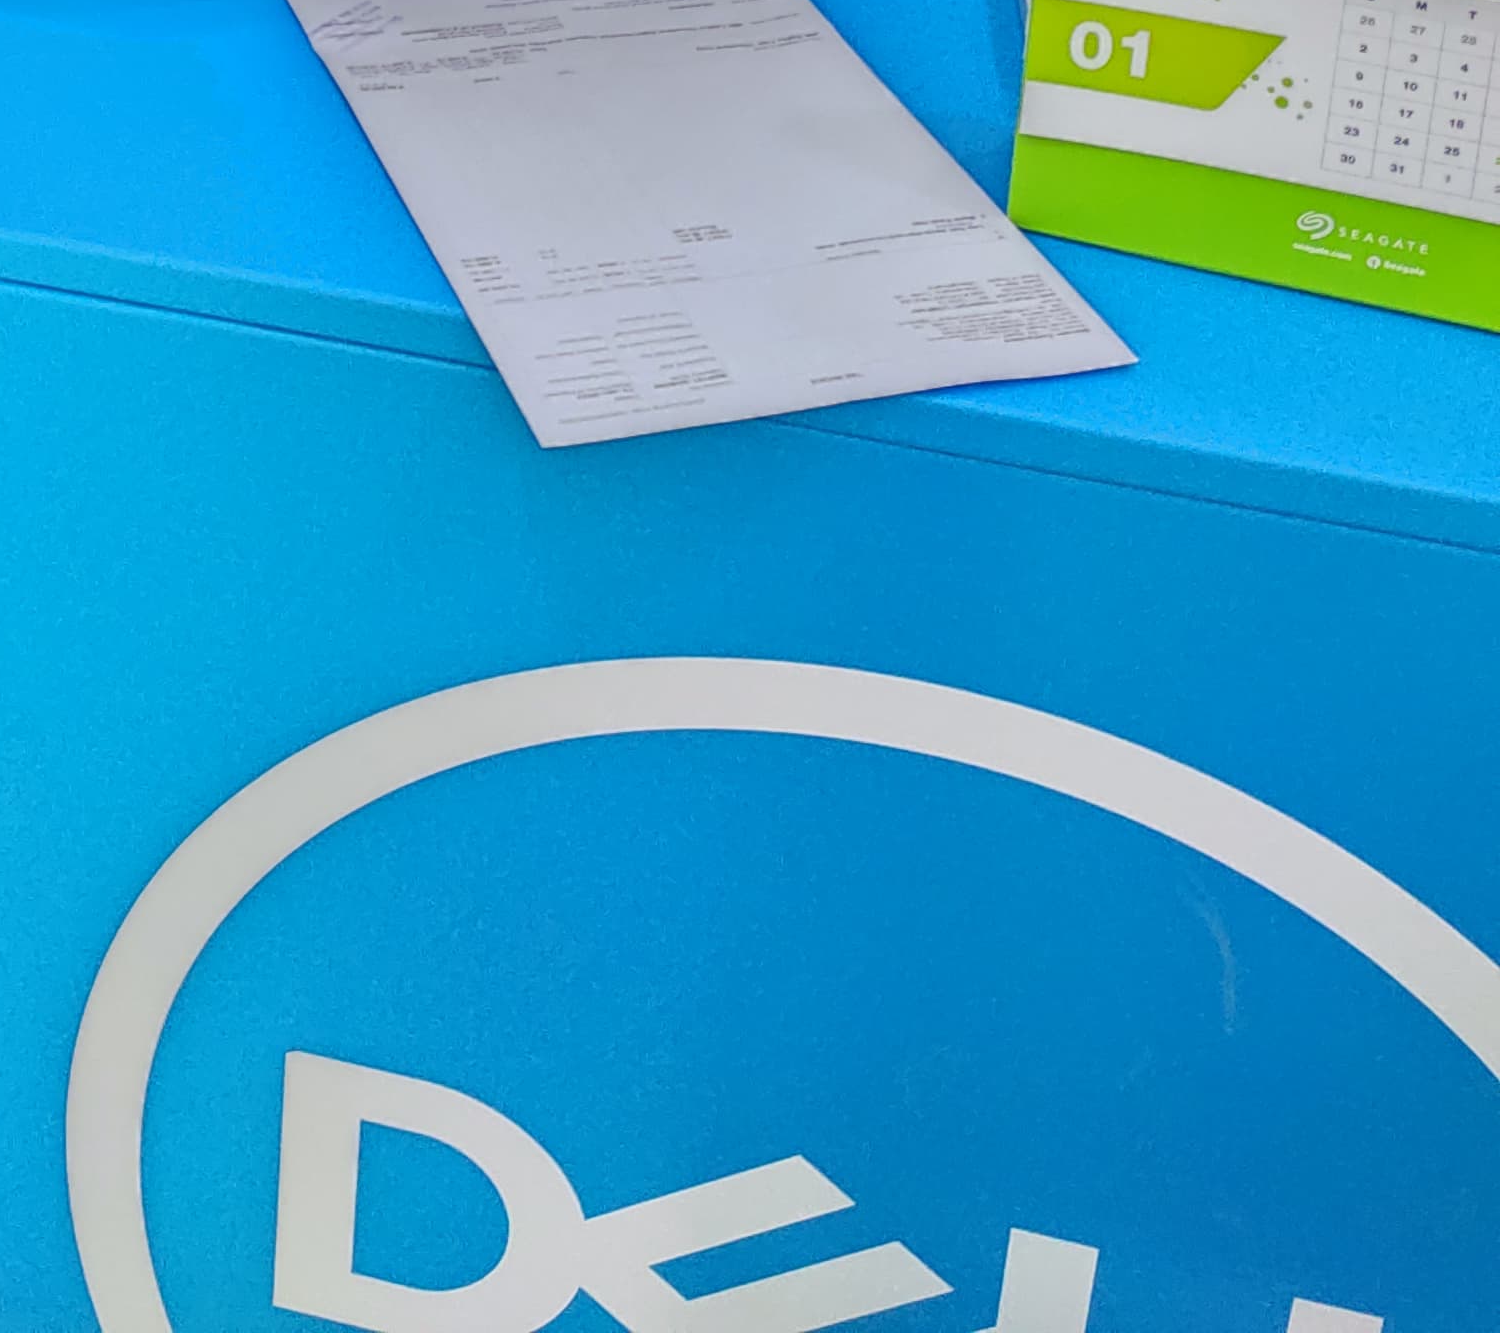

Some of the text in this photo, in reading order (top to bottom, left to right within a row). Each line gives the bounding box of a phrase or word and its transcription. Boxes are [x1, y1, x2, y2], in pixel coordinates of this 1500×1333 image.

[1416, 0, 1428, 12] M
[1468, 10, 1478, 20] T
[1410, 25, 1426, 36] 27
[1069, 20, 1151, 80] 01
[1359, 44, 1469, 73] 2 3 4
[1403, 81, 1418, 92] 10
[1453, 91, 1467, 101] 11
[1349, 99, 1464, 129] 16 17 18
[1343, 126, 1460, 157] 23 24 25
[1340, 154, 1356, 165] 30
[1390, 163, 1405, 175] 31
[1338, 226, 1429, 255] SEAGATE
